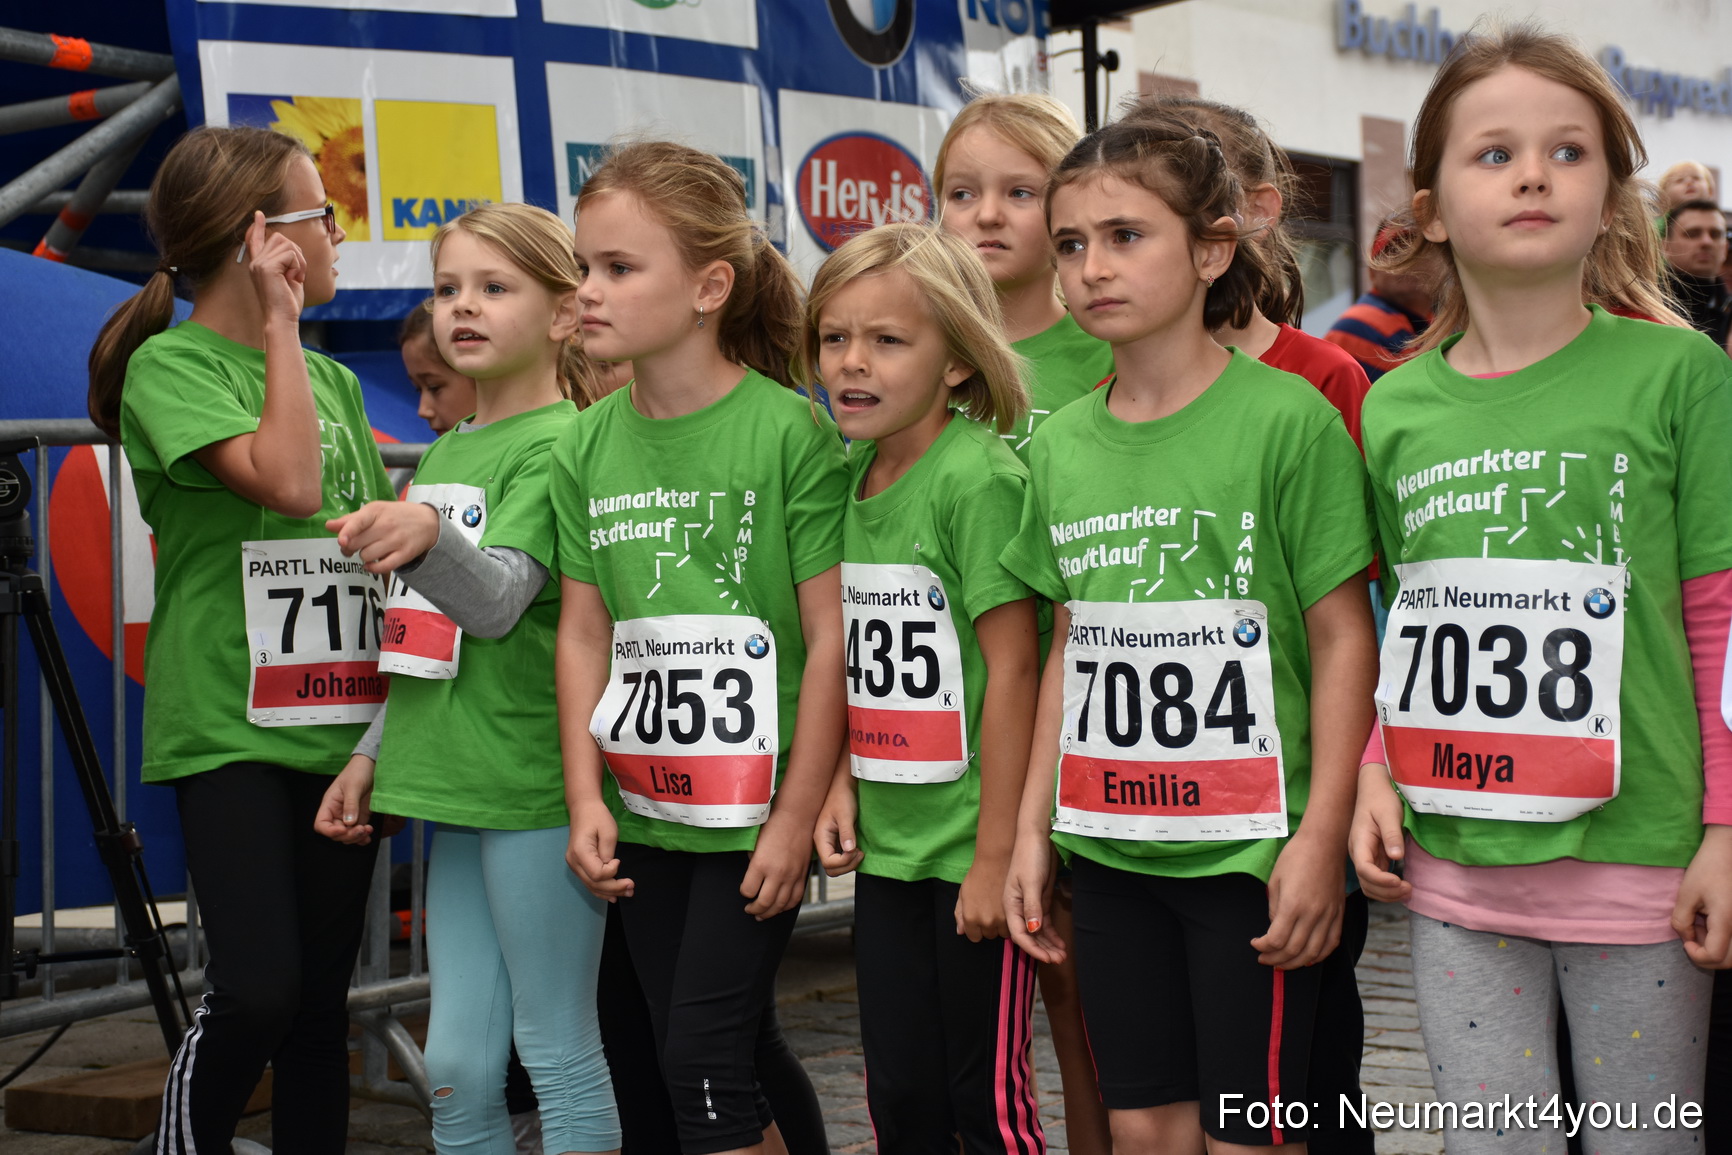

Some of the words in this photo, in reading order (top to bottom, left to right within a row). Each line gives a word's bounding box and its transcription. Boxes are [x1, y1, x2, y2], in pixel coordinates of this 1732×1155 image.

[810, 158, 922, 228] Hervis
[1396, 448, 1547, 503] Neumarkter
[588, 486, 700, 518] Neumarkter
[1404, 482, 1509, 537] Stadtlauf
[589, 517, 677, 550] Stdtlauf
[1050, 506, 1182, 547] Neumarkter
[249, 559, 314, 578] PARTL
[1058, 537, 1150, 580] Stadtlauf
[848, 585, 921, 607] Neumarkt
[1397, 586, 1439, 611] PARTL
[1443, 586, 1572, 612] Neumarkt
[267, 585, 385, 655] 7176
[1068, 623, 1108, 647] PARTL
[1110, 625, 1226, 648] Neumarkt
[259, 652, 268, 664] 3
[615, 641, 644, 660] PARTL
[645, 637, 735, 658] Neumarkt
[296, 670, 383, 699] Johanna
[1398, 623, 1594, 723] 7038
[610, 667, 756, 745] 7053
[943, 692, 952, 707] K
[1076, 660, 1257, 749] 7084
[1381, 706, 1389, 722] 3
[1594, 717, 1605, 734] K
[758, 737, 767, 751] K
[1257, 737, 1269, 753] K
[650, 765, 693, 796] Lisa
[1432, 742, 1515, 790] Maya
[1103, 771, 1201, 807] Emilia
